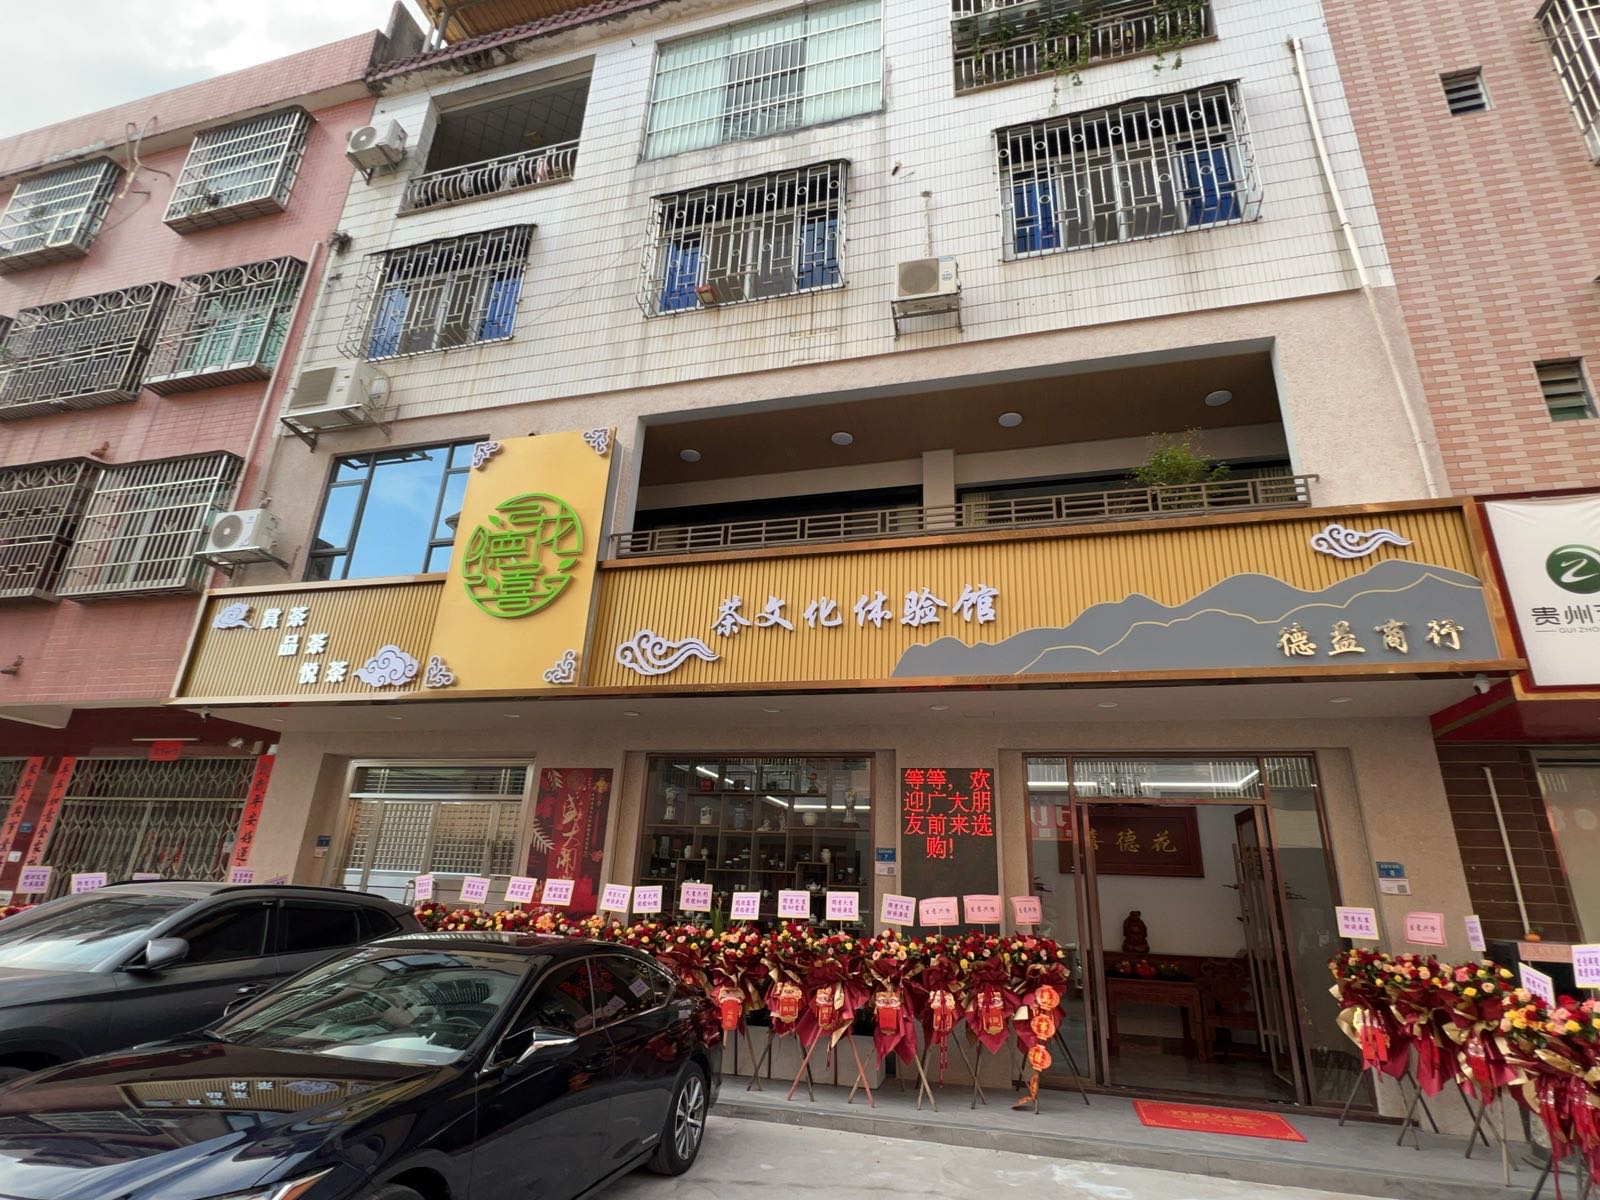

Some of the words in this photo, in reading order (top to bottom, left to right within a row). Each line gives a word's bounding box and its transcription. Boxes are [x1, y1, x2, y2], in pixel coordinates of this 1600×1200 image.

[711, 584, 999, 637] 茶文化体验馆
[277, 632, 329, 656] 品茶
[903, 791, 991, 813] 迎广大朋
[903, 812, 993, 837] 友前来选
